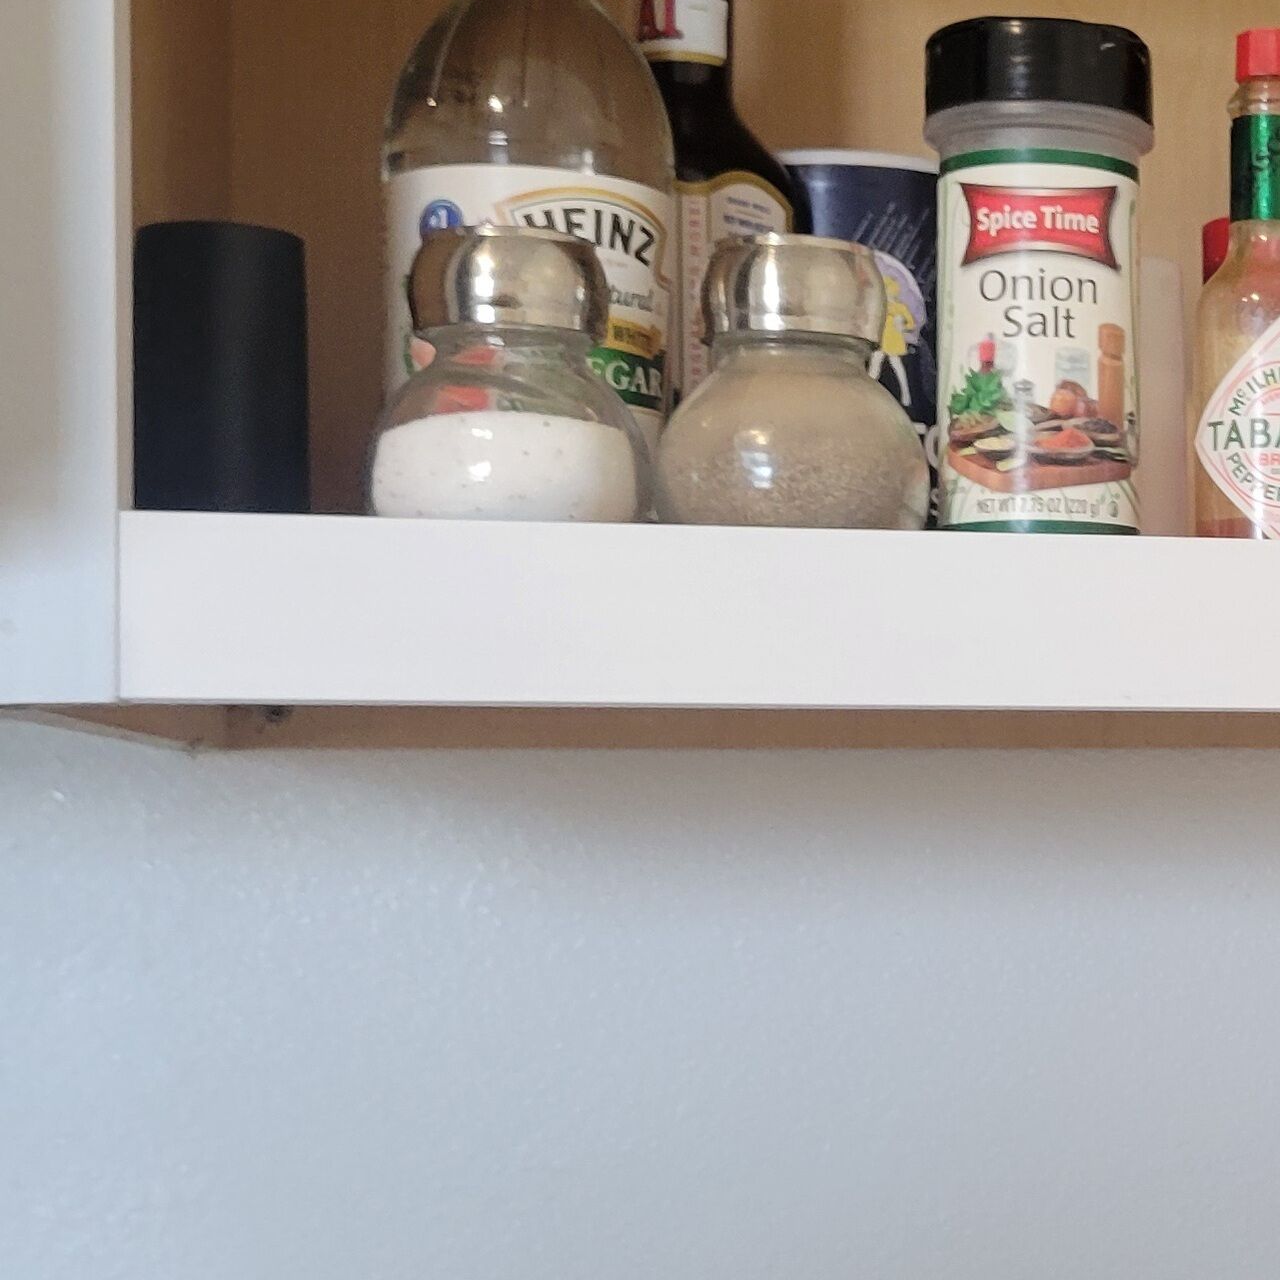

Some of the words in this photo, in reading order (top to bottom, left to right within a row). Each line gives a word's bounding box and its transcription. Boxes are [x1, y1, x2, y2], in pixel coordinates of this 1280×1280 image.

[521, 206, 657, 269] HEINZ
[976, 205, 1037, 237] Spice
[1039, 204, 1100, 234] Time
[979, 267, 1097, 305] Onion
[1002, 305, 1076, 339] Salt
